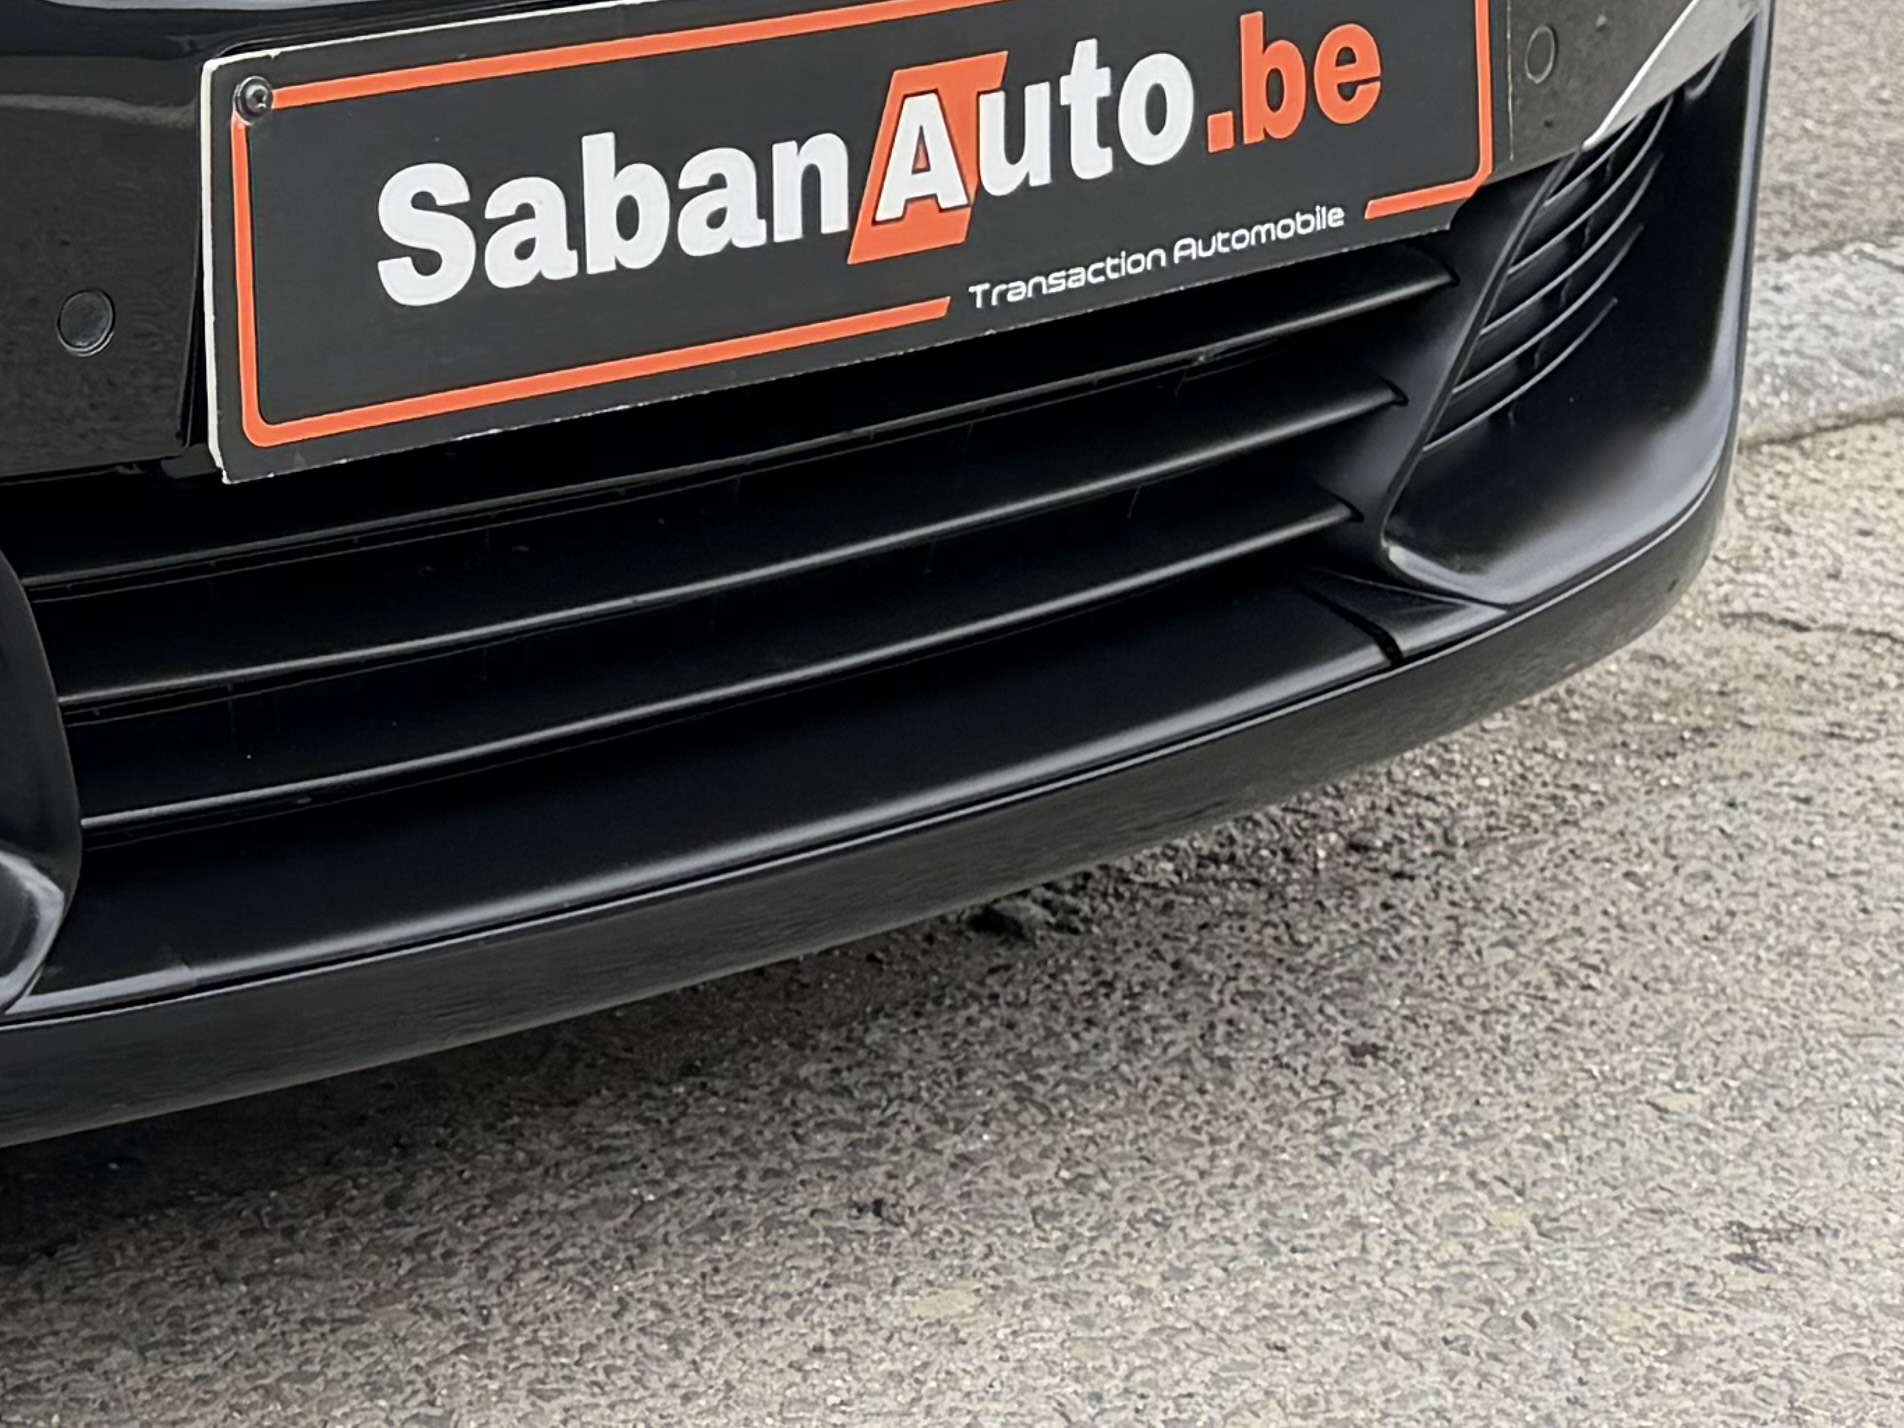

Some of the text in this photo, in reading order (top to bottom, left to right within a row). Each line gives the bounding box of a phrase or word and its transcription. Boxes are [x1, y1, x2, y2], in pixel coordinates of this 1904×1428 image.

[376, 10, 1383, 307] SabanAuto.be
[969, 205, 1345, 309] Transaction Automobile
